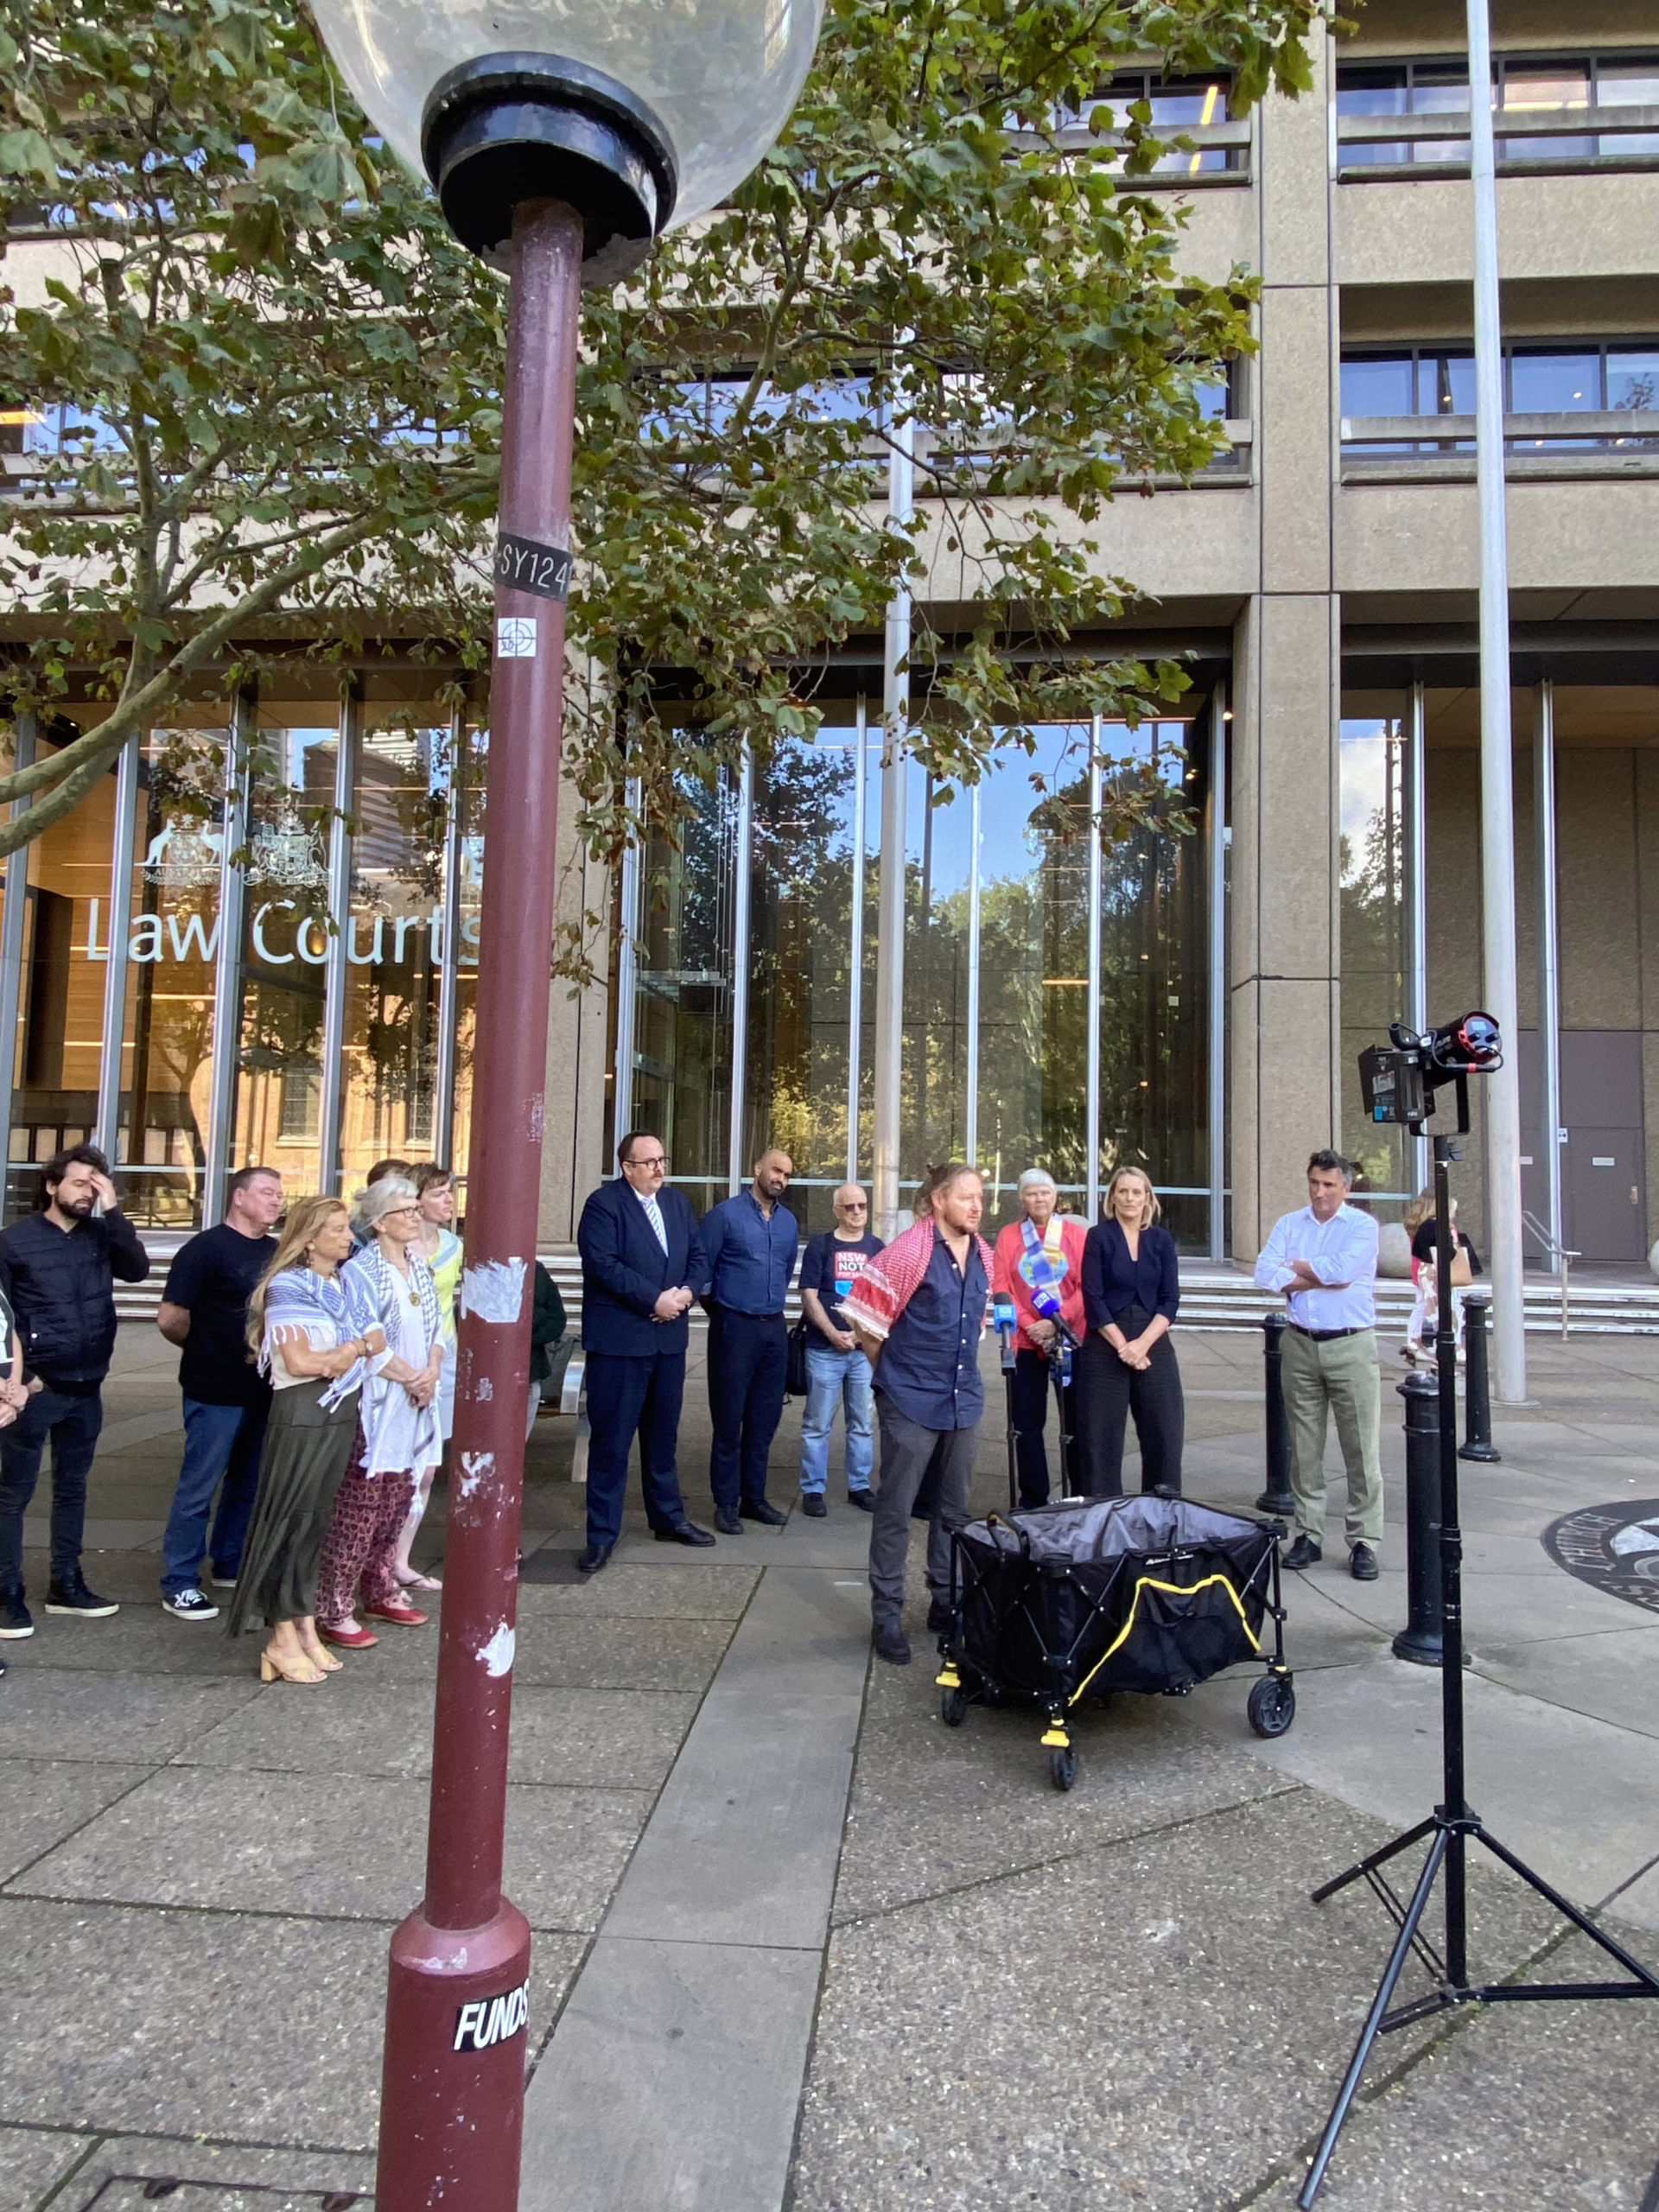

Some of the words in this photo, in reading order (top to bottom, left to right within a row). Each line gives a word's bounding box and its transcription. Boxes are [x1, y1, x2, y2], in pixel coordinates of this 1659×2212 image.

[500, 543, 573, 592] SY124
[87, 898, 222, 963] Law
[253, 899, 480, 965] Courts
[838, 1253, 867, 1262] NSW
[839, 1262, 865, 1271] NOT
[1555, 1513, 1624, 1571] CHURCH
[454, 1978, 530, 2050] FUNDS
